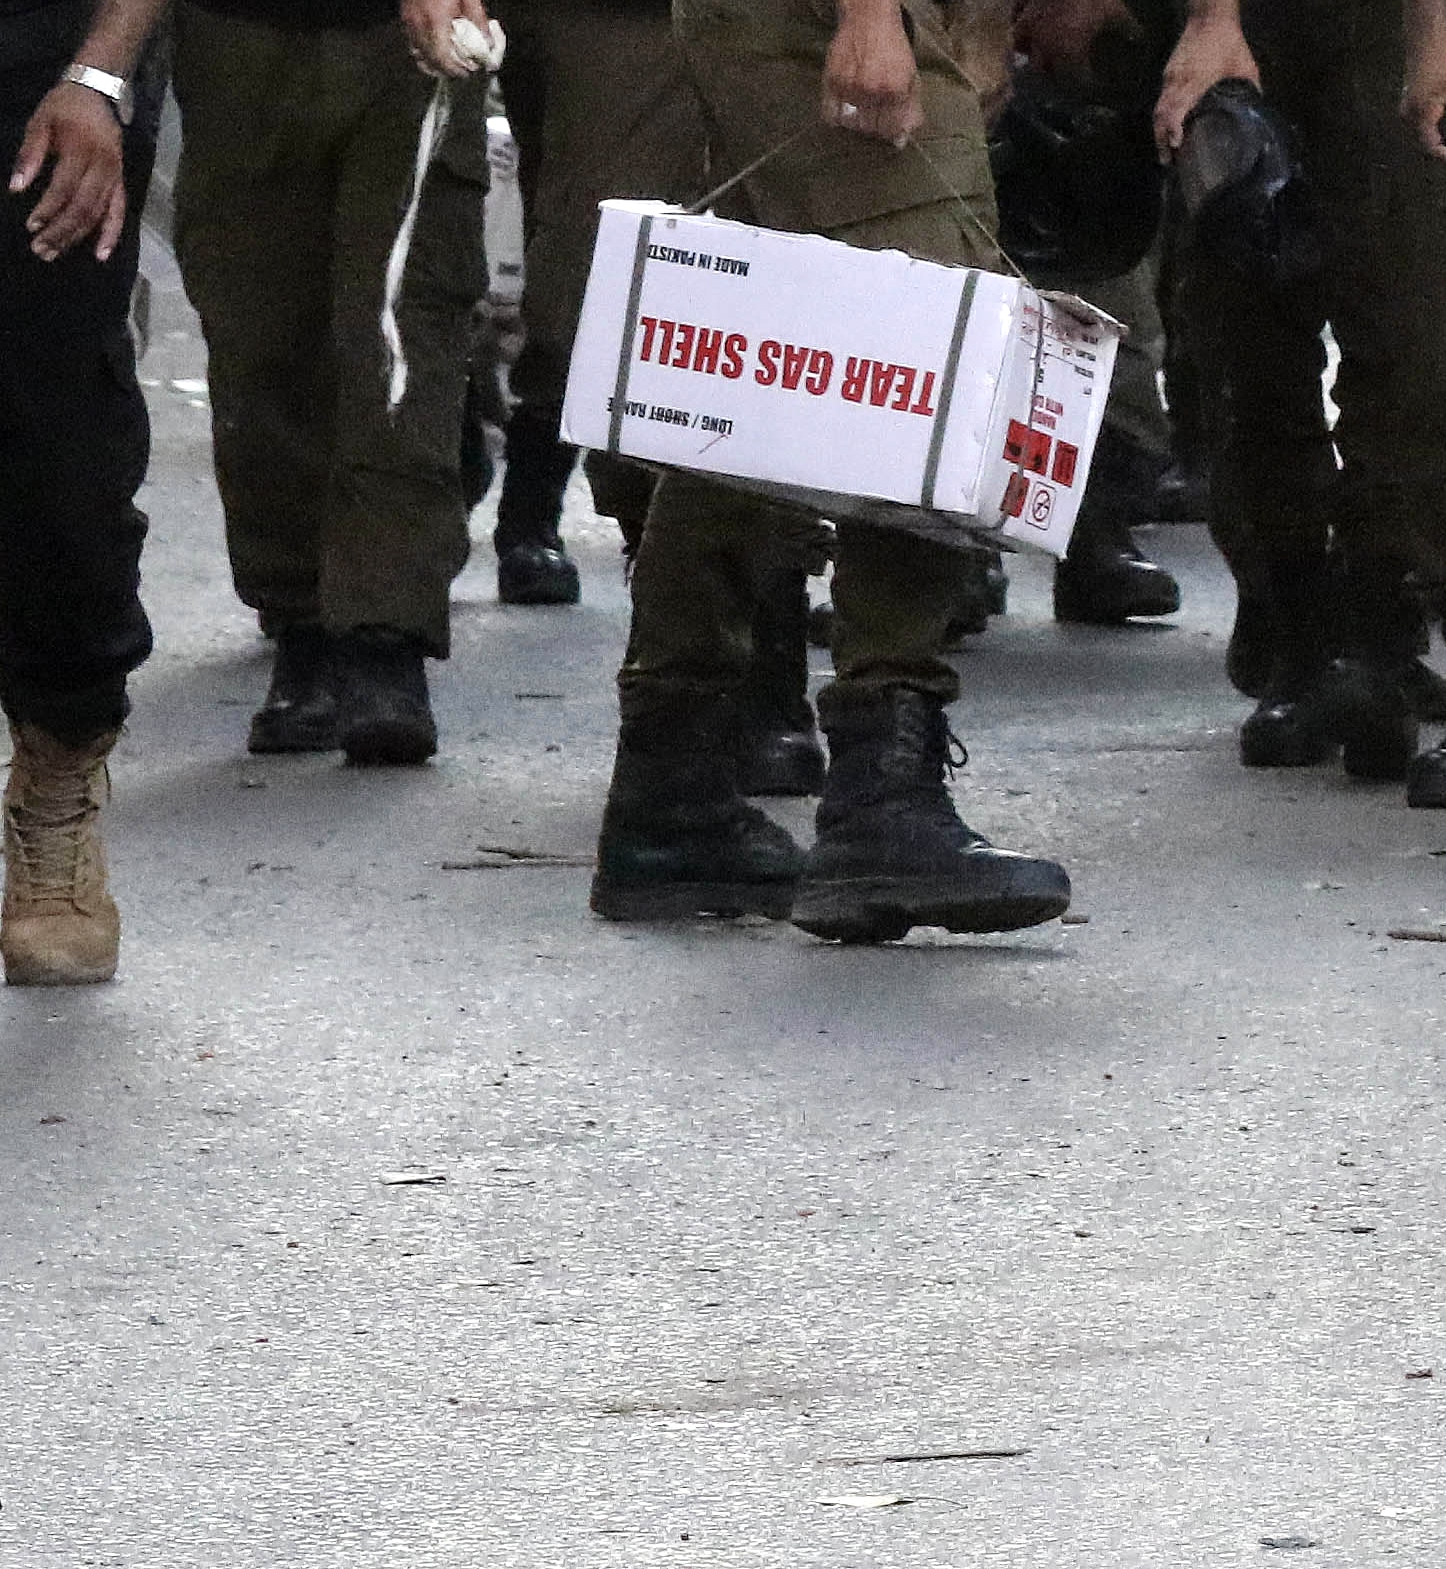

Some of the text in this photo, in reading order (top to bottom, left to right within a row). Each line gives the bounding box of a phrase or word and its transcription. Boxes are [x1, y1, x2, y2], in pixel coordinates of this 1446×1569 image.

[698, 253, 713, 270] IN
[713, 256, 750, 277] MADE
[640, 316, 936, 417] TEAR GAS SHELL
[701, 415, 734, 436] LONG
